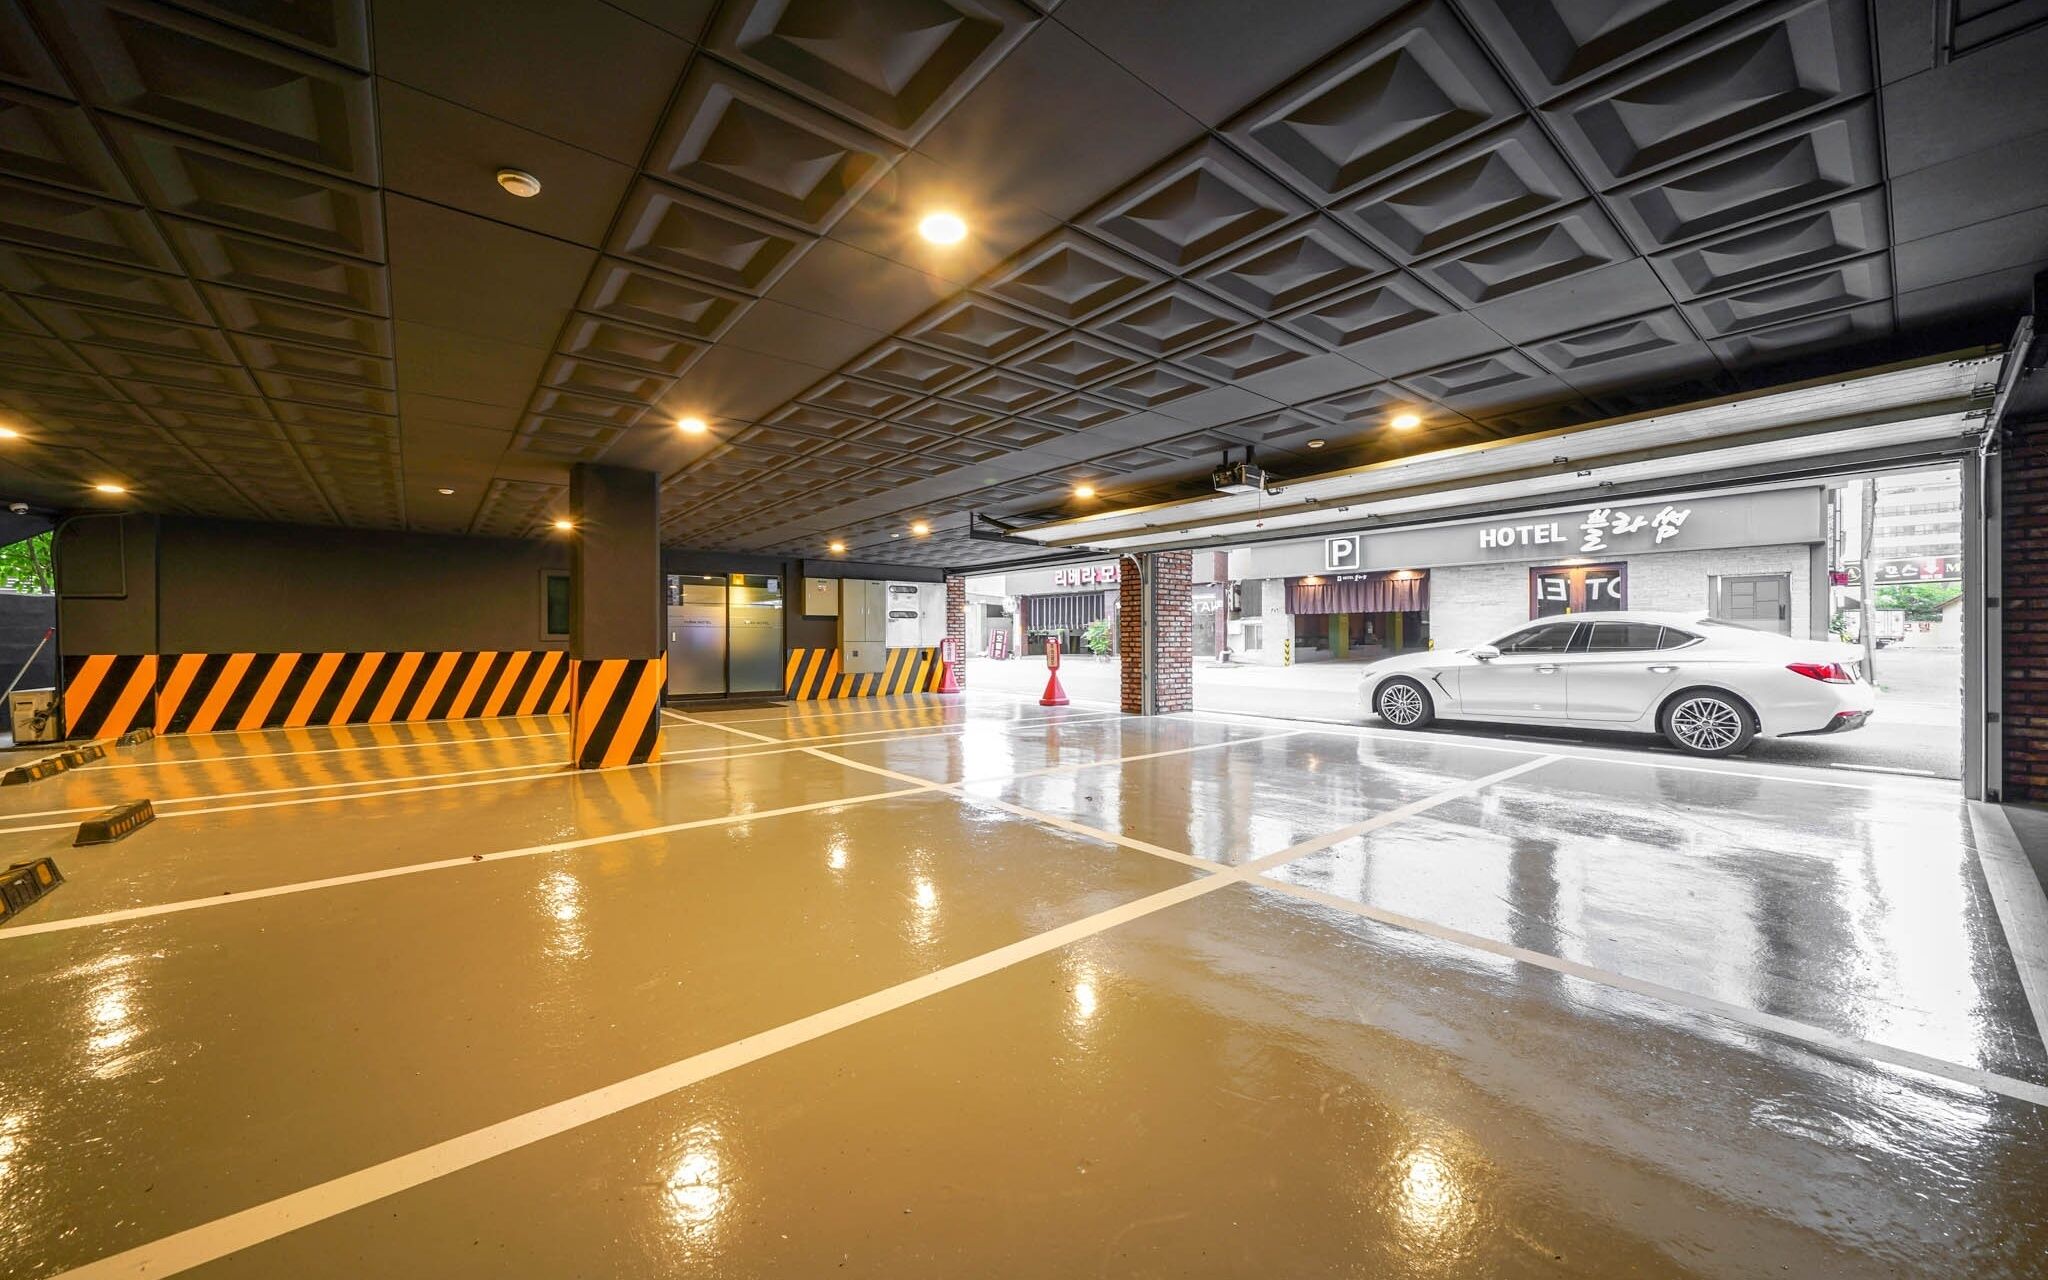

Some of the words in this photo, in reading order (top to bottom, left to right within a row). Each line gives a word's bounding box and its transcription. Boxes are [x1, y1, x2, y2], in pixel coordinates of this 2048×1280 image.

[1480, 522, 1568, 548] HOTEL
[1332, 540, 1352, 566] P
[1055, 566, 1096, 586] 리베라
[1101, 565, 1121, 582] 모
